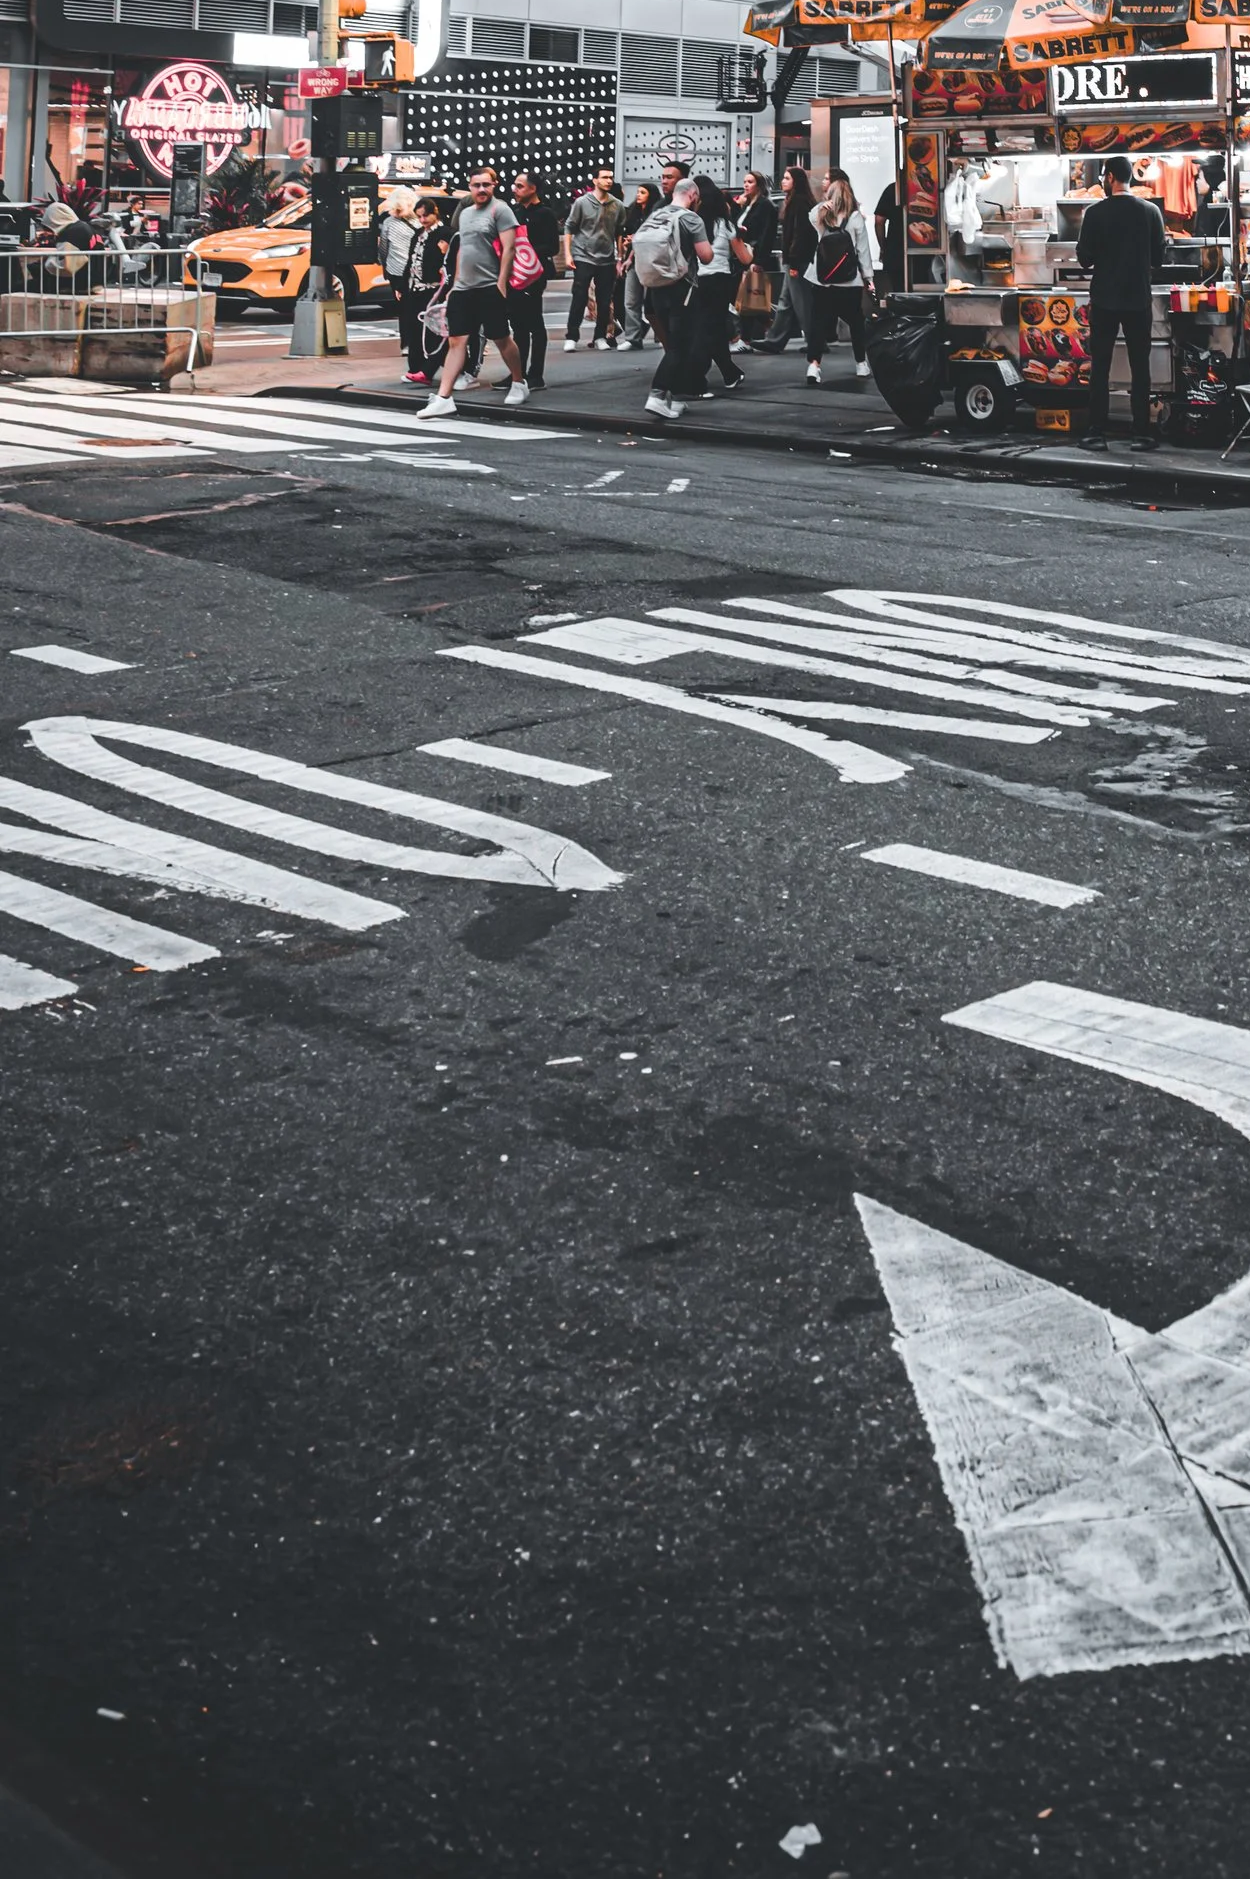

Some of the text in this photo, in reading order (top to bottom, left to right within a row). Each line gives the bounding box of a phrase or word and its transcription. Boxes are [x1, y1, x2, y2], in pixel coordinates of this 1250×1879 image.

[1014, 31, 1129, 63] SABRETT
[163, 71, 218, 98] HOT
[307, 78, 339, 87] WRONG
[313, 87, 333, 95] WAY
[130, 128, 243, 145] ORIGINAL GLAZED
